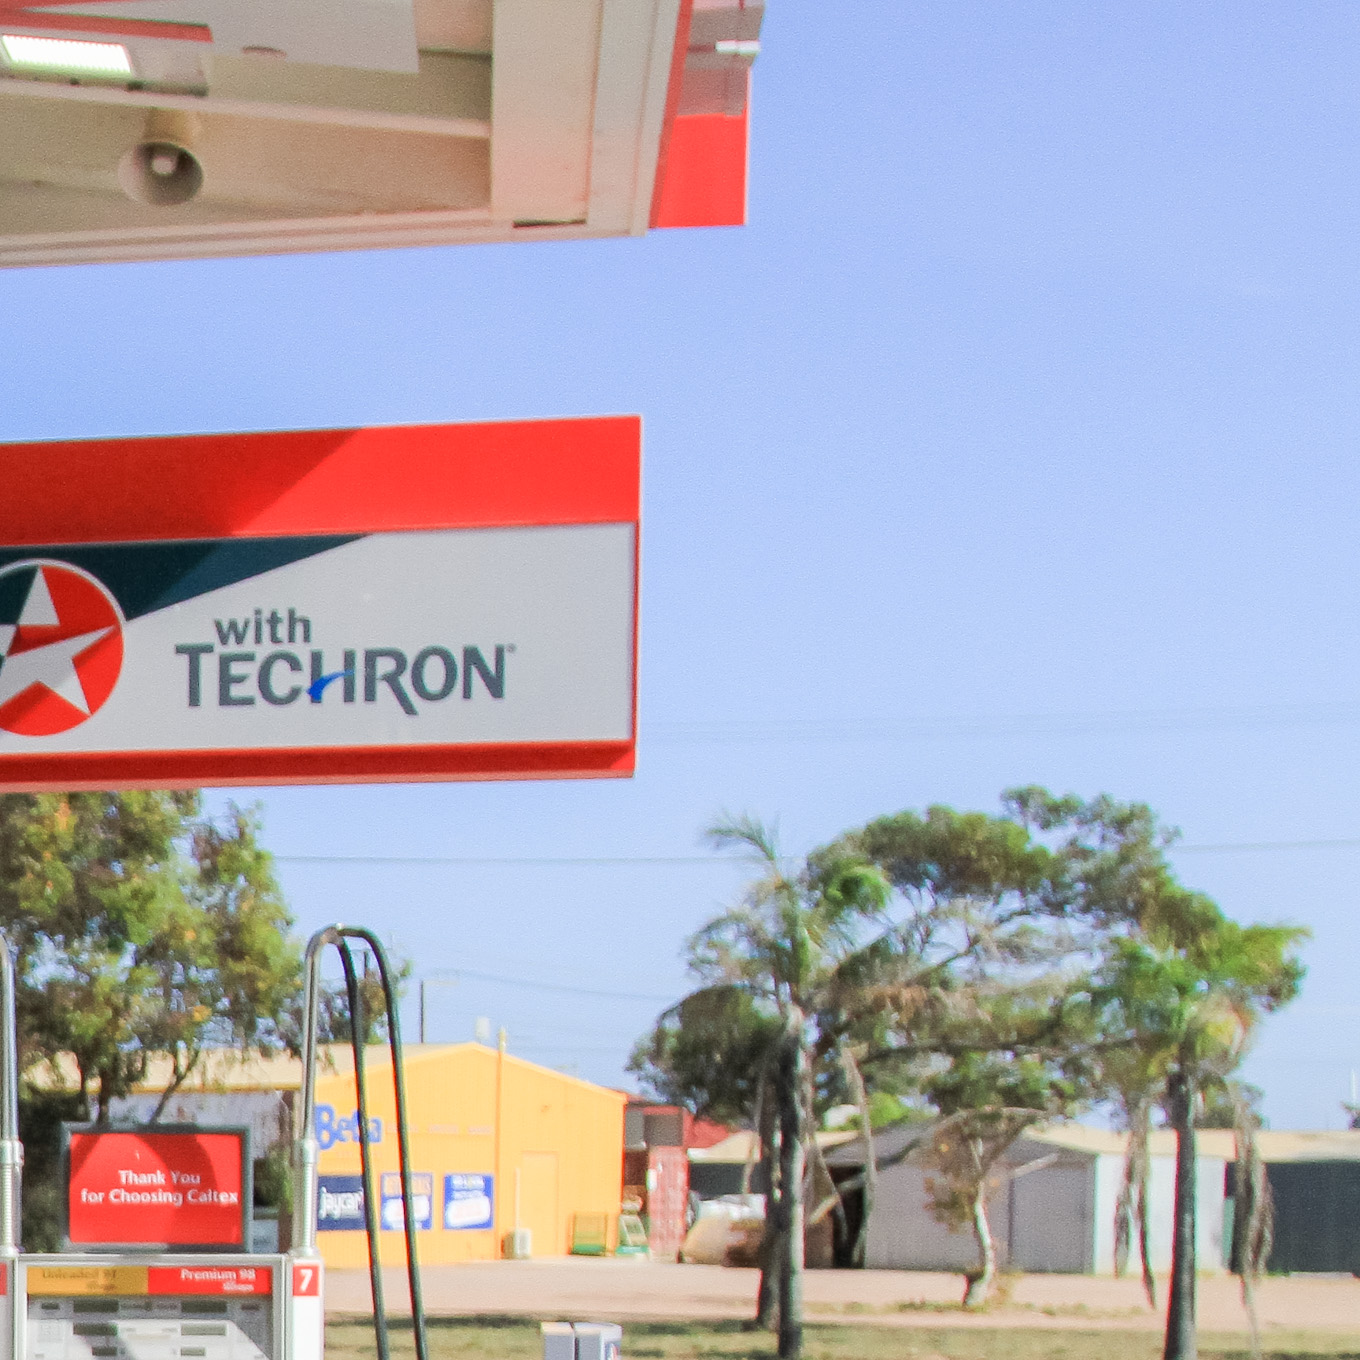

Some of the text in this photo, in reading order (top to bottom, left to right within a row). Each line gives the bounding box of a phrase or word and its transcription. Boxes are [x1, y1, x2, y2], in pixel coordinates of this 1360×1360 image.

[214, 608, 311, 646] with
[175, 643, 507, 716] TECHRON
[118, 1170, 201, 1185] Thank You
[81, 1188, 239, 1207] for Choosing Caltex
[180, 1268, 256, 1280] Premium 98
[300, 1269, 313, 1292] 7
